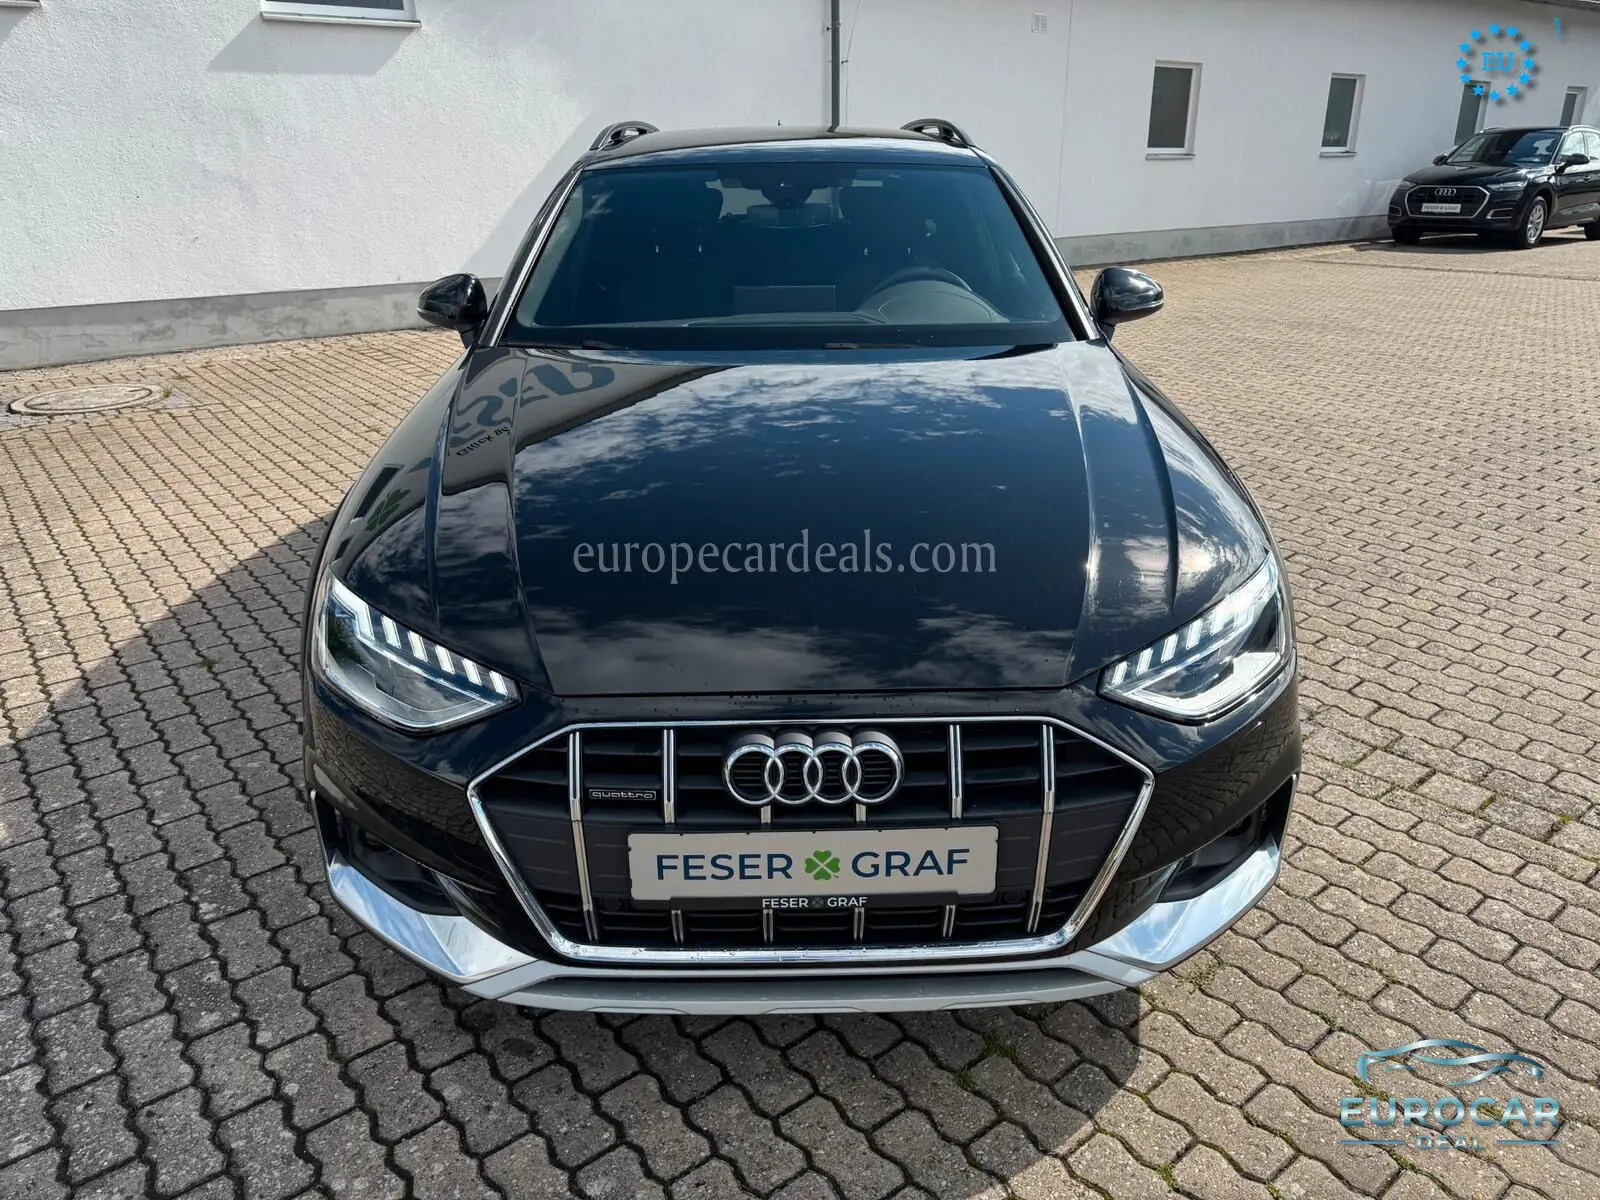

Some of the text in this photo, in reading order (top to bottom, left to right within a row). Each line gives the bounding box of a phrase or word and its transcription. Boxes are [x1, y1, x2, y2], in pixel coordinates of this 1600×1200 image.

[592, 791, 653, 799] quattro
[656, 848, 970, 881] FESER GRAF
[762, 897, 867, 909] FESER GRAF
